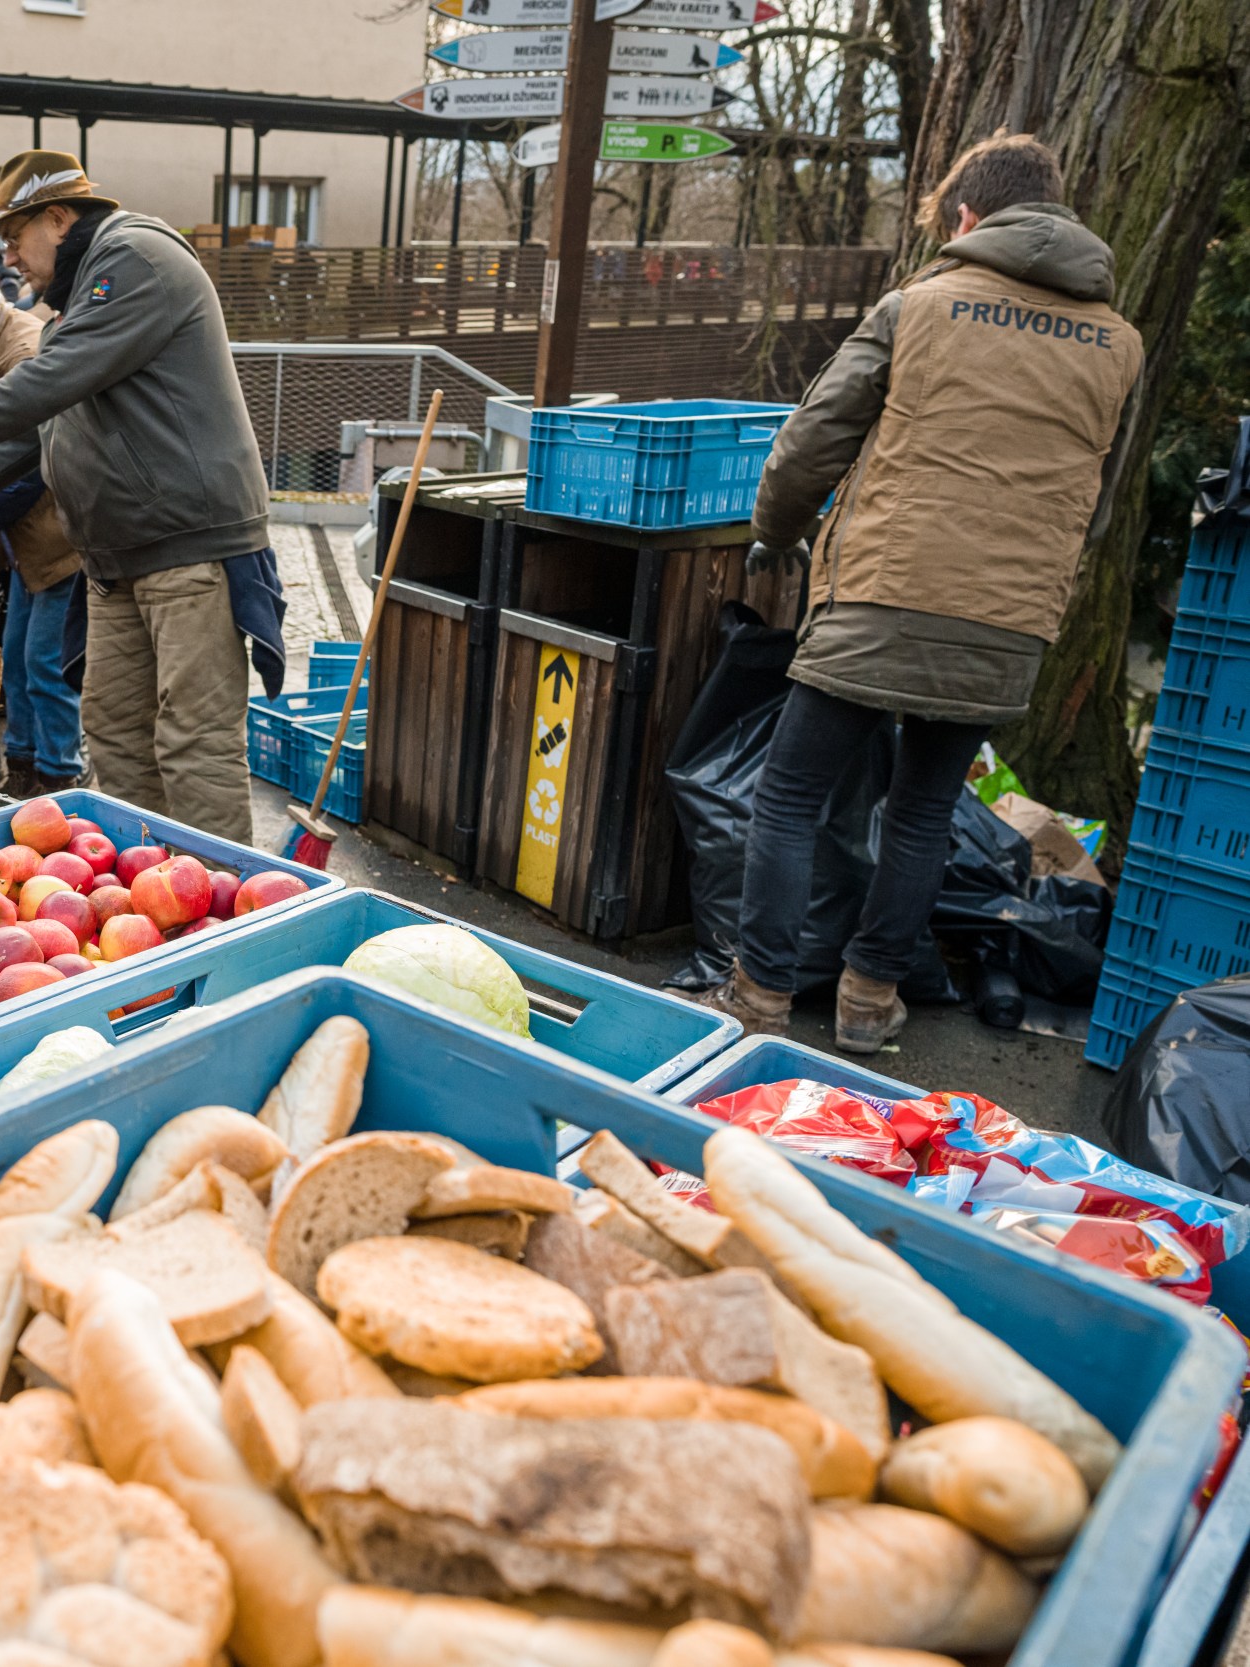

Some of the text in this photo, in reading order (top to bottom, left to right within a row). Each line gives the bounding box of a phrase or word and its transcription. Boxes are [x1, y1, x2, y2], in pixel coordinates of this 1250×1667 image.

[617, 46, 668, 58] LACHTANI
[612, 90, 629, 100] WC
[607, 135, 648, 148] VÝCHOD
[661, 134, 674, 152] P
[951, 298, 1112, 349] PRŮVODCE
[525, 823, 558, 848] PLAST
